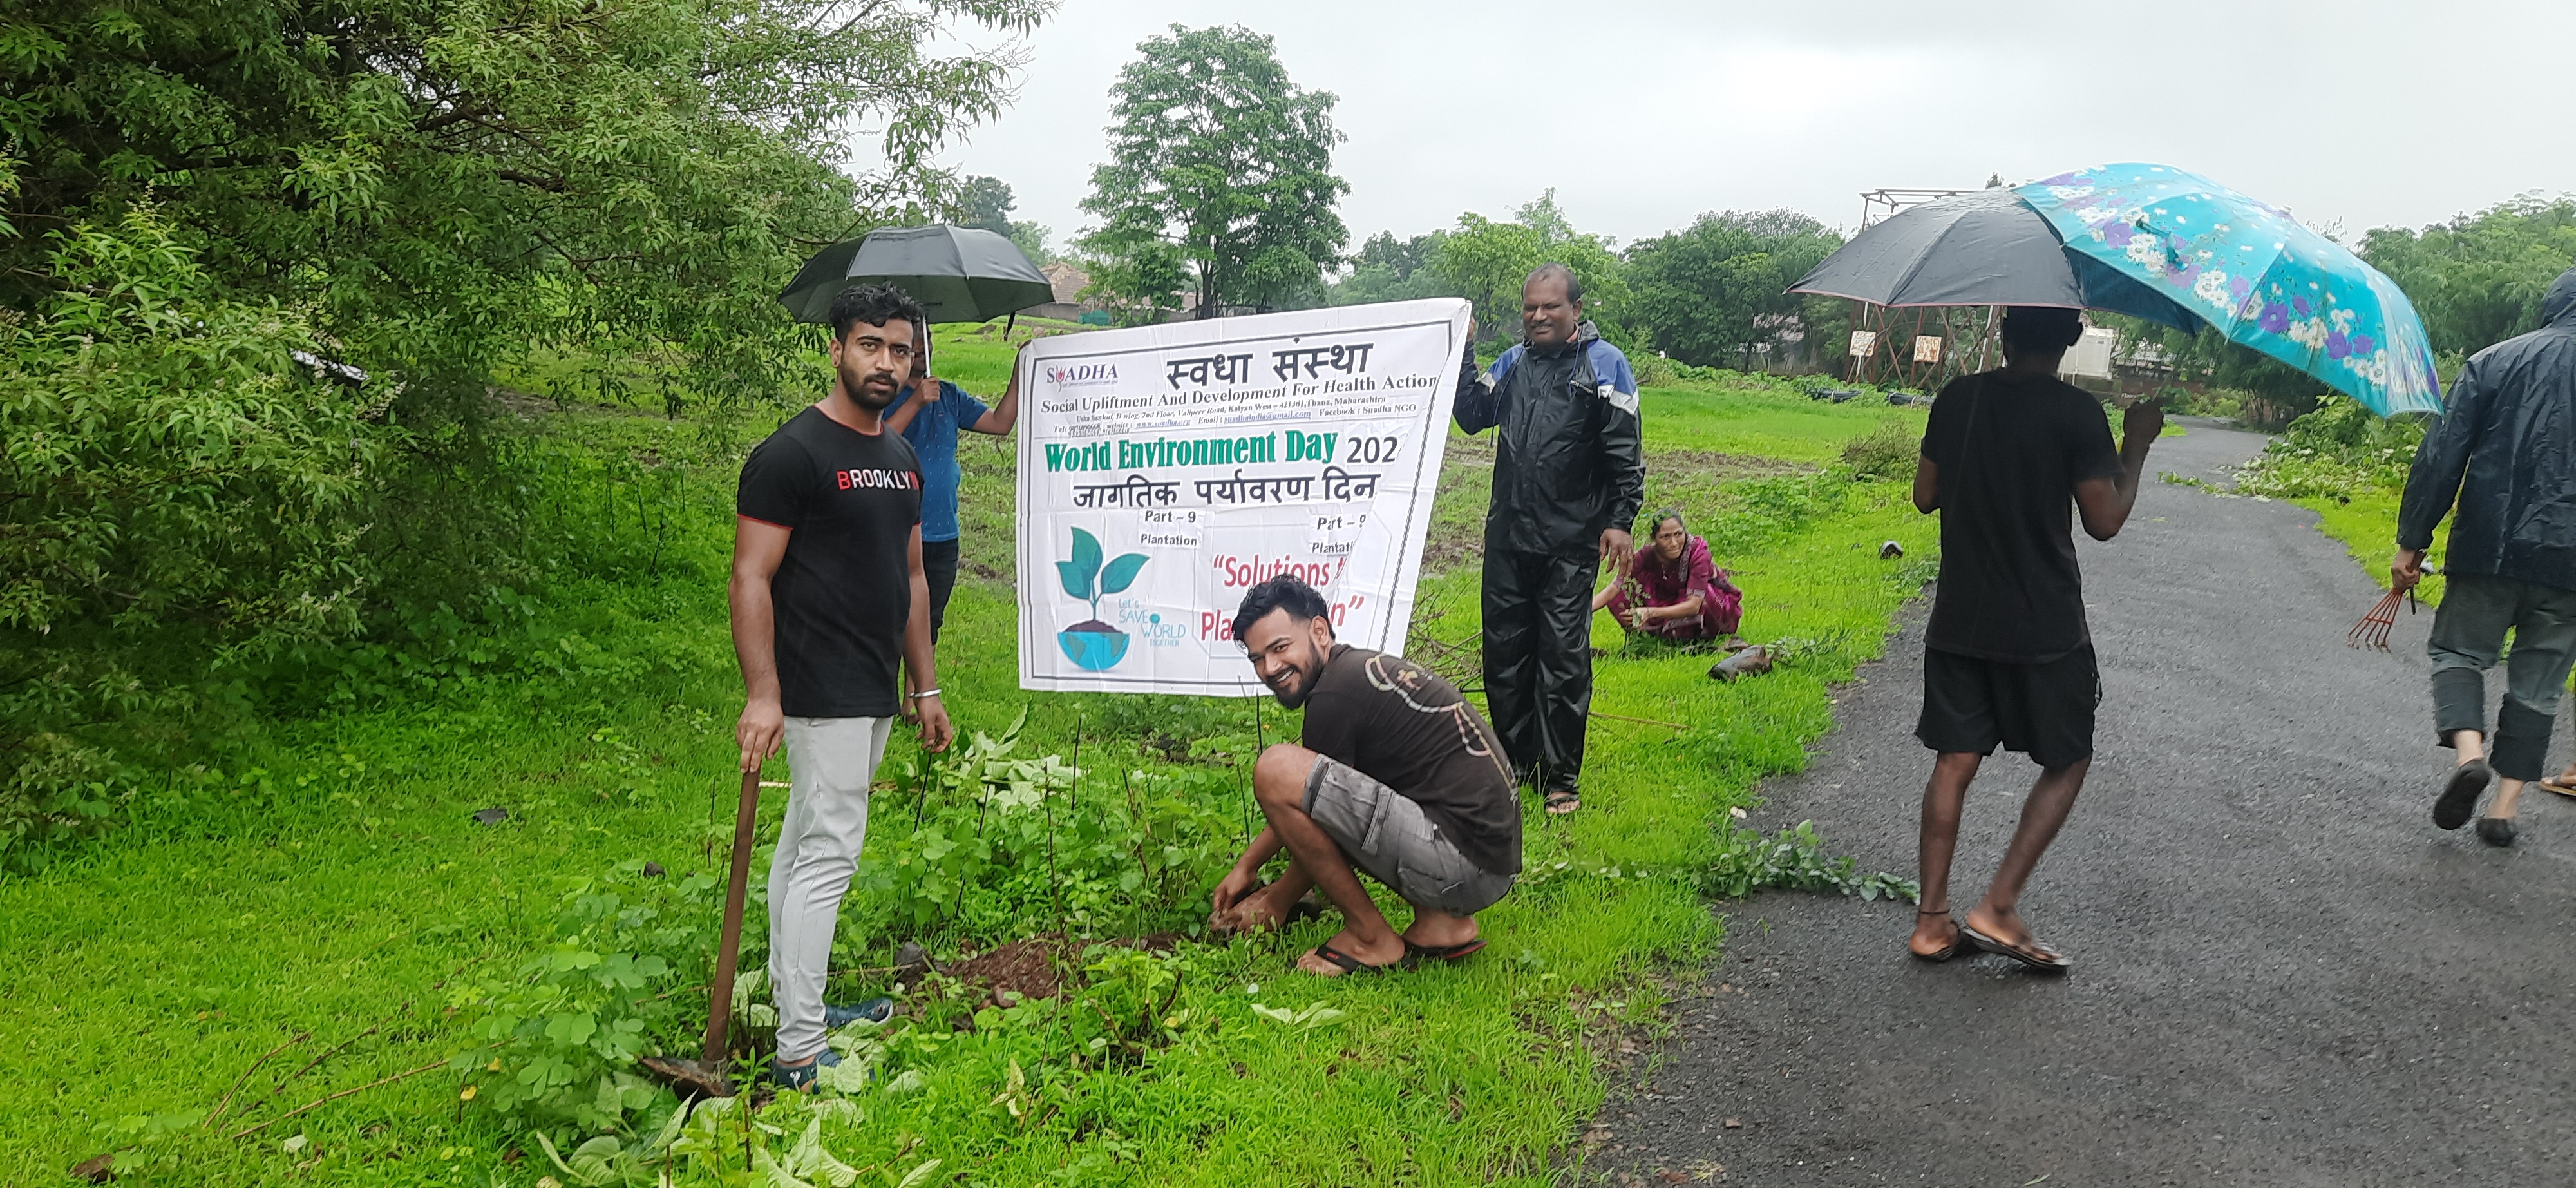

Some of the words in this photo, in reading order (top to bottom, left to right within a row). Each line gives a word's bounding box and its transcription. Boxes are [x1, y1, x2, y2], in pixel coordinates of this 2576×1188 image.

[1166, 352, 1253, 390] स्वधा
[1273, 337, 1374, 381] संस्था
[1041, 398, 1078, 414] Social
[1083, 394, 1153, 414] Upliftment
[1157, 391, 1186, 407] And
[1192, 386, 1288, 405] Development
[1292, 382, 1319, 397] For
[1323, 376, 1376, 394] Health
[1228, 405, 1253, 413] Kalyan
[1334, 395, 1386, 405] Maharashtra
[1320, 407, 1356, 417] Facebook
[1394, 404, 1416, 413] NGO
[1045, 440, 1112, 472] World
[1118, 430, 1276, 469] Environment
[1285, 429, 1340, 464] Day
[1347, 436, 1402, 463] 202
[1073, 474, 1180, 509] जागतिक
[1194, 468, 1316, 504] पर्यावरण
[1321, 465, 1381, 503] दिन
[1144, 510, 1173, 523] Part
[1188, 511, 1197, 523] 9
[1140, 534, 1197, 546] Plantation
[1119, 609, 1148, 624] SAVE
[1141, 623, 1186, 638] WORLD
